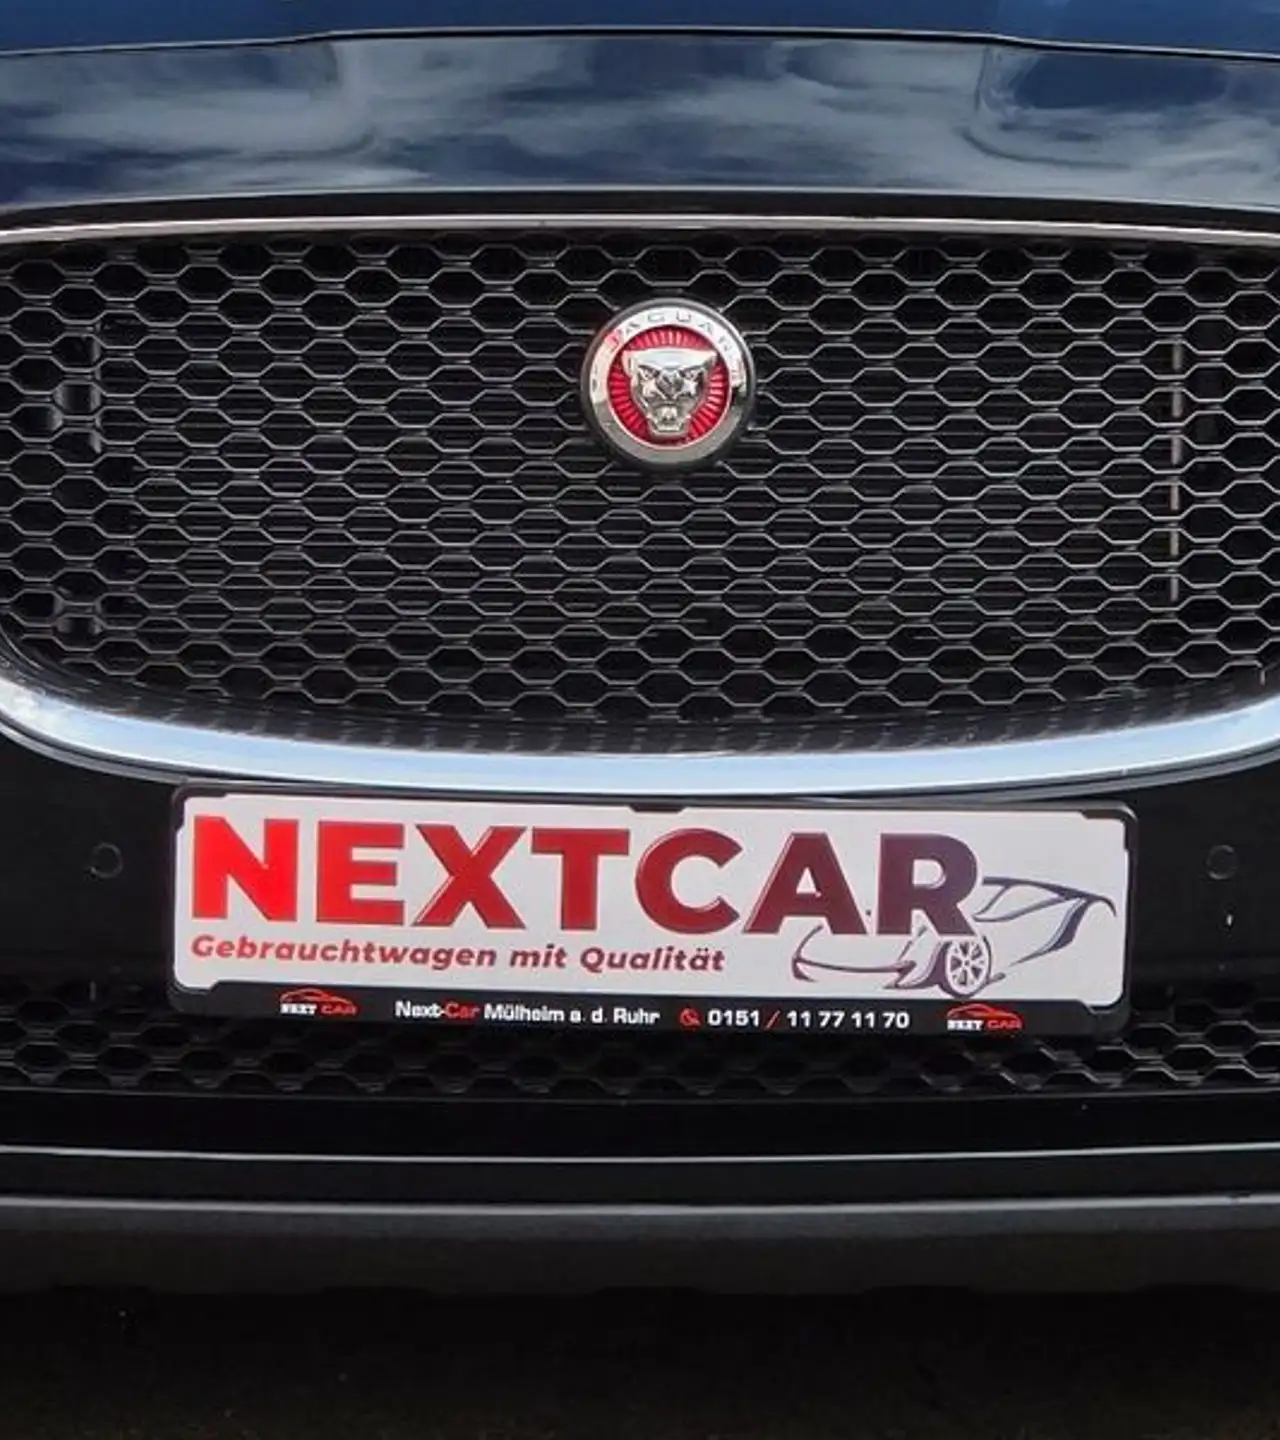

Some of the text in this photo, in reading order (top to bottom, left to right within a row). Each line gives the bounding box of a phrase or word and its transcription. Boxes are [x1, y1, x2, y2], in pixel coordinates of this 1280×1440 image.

[191, 815, 979, 937] NEXTCAR
[191, 934, 726, 974] Gebrauchtwagen mit Qualität
[394, 1000, 480, 1019] Next-Car
[483, 1003, 566, 1023] Mülheim
[613, 1007, 661, 1025] Ruhr
[707, 1009, 761, 1027] 0151
[786, 1010, 812, 1028] 11
[819, 1011, 846, 1029] 77
[850, 1011, 876, 1029] 11
[883, 1012, 911, 1030] 70
